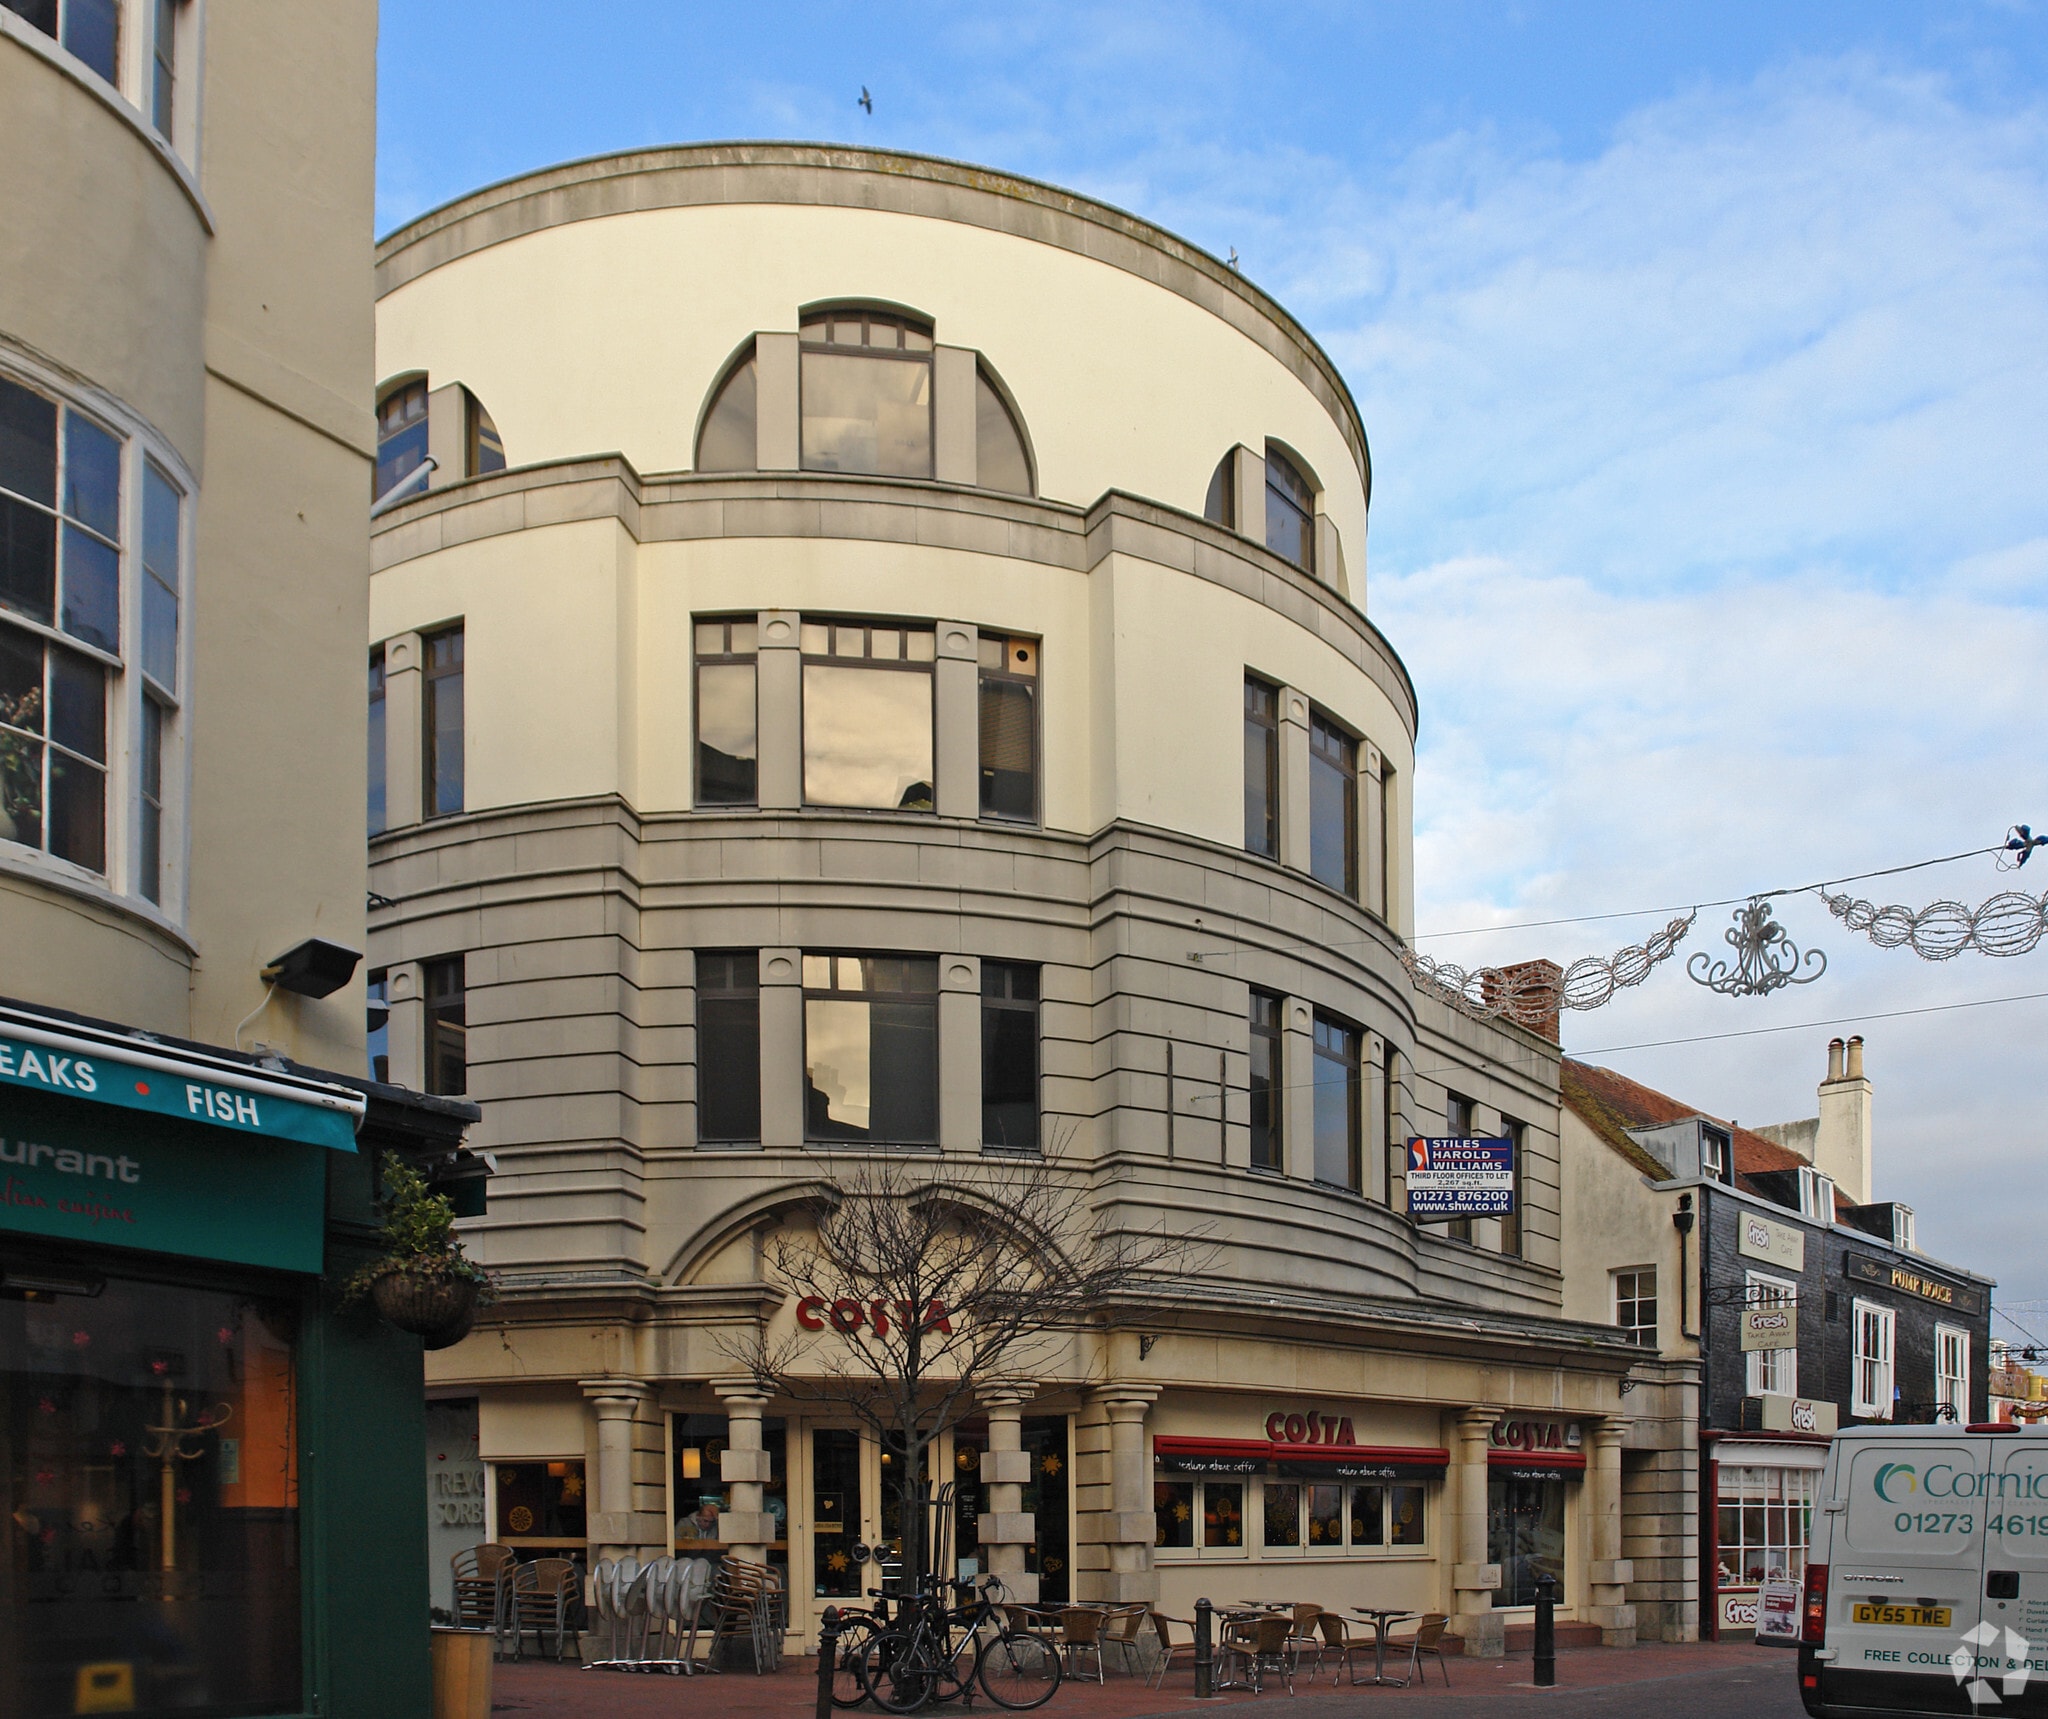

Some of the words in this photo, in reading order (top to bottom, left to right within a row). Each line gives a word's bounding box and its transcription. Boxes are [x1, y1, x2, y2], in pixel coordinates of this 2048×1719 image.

[185, 1084, 260, 1126] FISH
[1432, 1139, 1480, 1148] STILES
[1432, 1150, 1491, 1159] HAROLD
[1433, 1161, 1503, 1170] WILLIAMS
[1412, 1191, 1453, 1201] 01273
[1458, 1191, 1508, 1201] 876200
[1412, 1201, 1508, 1211] www.shw.co.uk
[57, 1190, 138, 1226] cuisine
[1891, 1268, 1921, 1293] PUMP
[1922, 1279, 1952, 1303] HOUSE
[796, 1295, 952, 1338] COSTA
[1750, 1312, 1788, 1330] fresh
[1265, 1410, 1356, 1445] COSTA
[1492, 1420, 1562, 1451] COSTA
[1894, 1512, 1973, 1534] 01273
[1725, 1598, 1759, 1623] fres
[1860, 1606, 1906, 1622] GY55
[1910, 1608, 1945, 1624] TWE
[1864, 1649, 1901, 1662] FREE
[1908, 1651, 2000, 1669] COLLECTION
[2006, 1658, 2016, 1669] &
